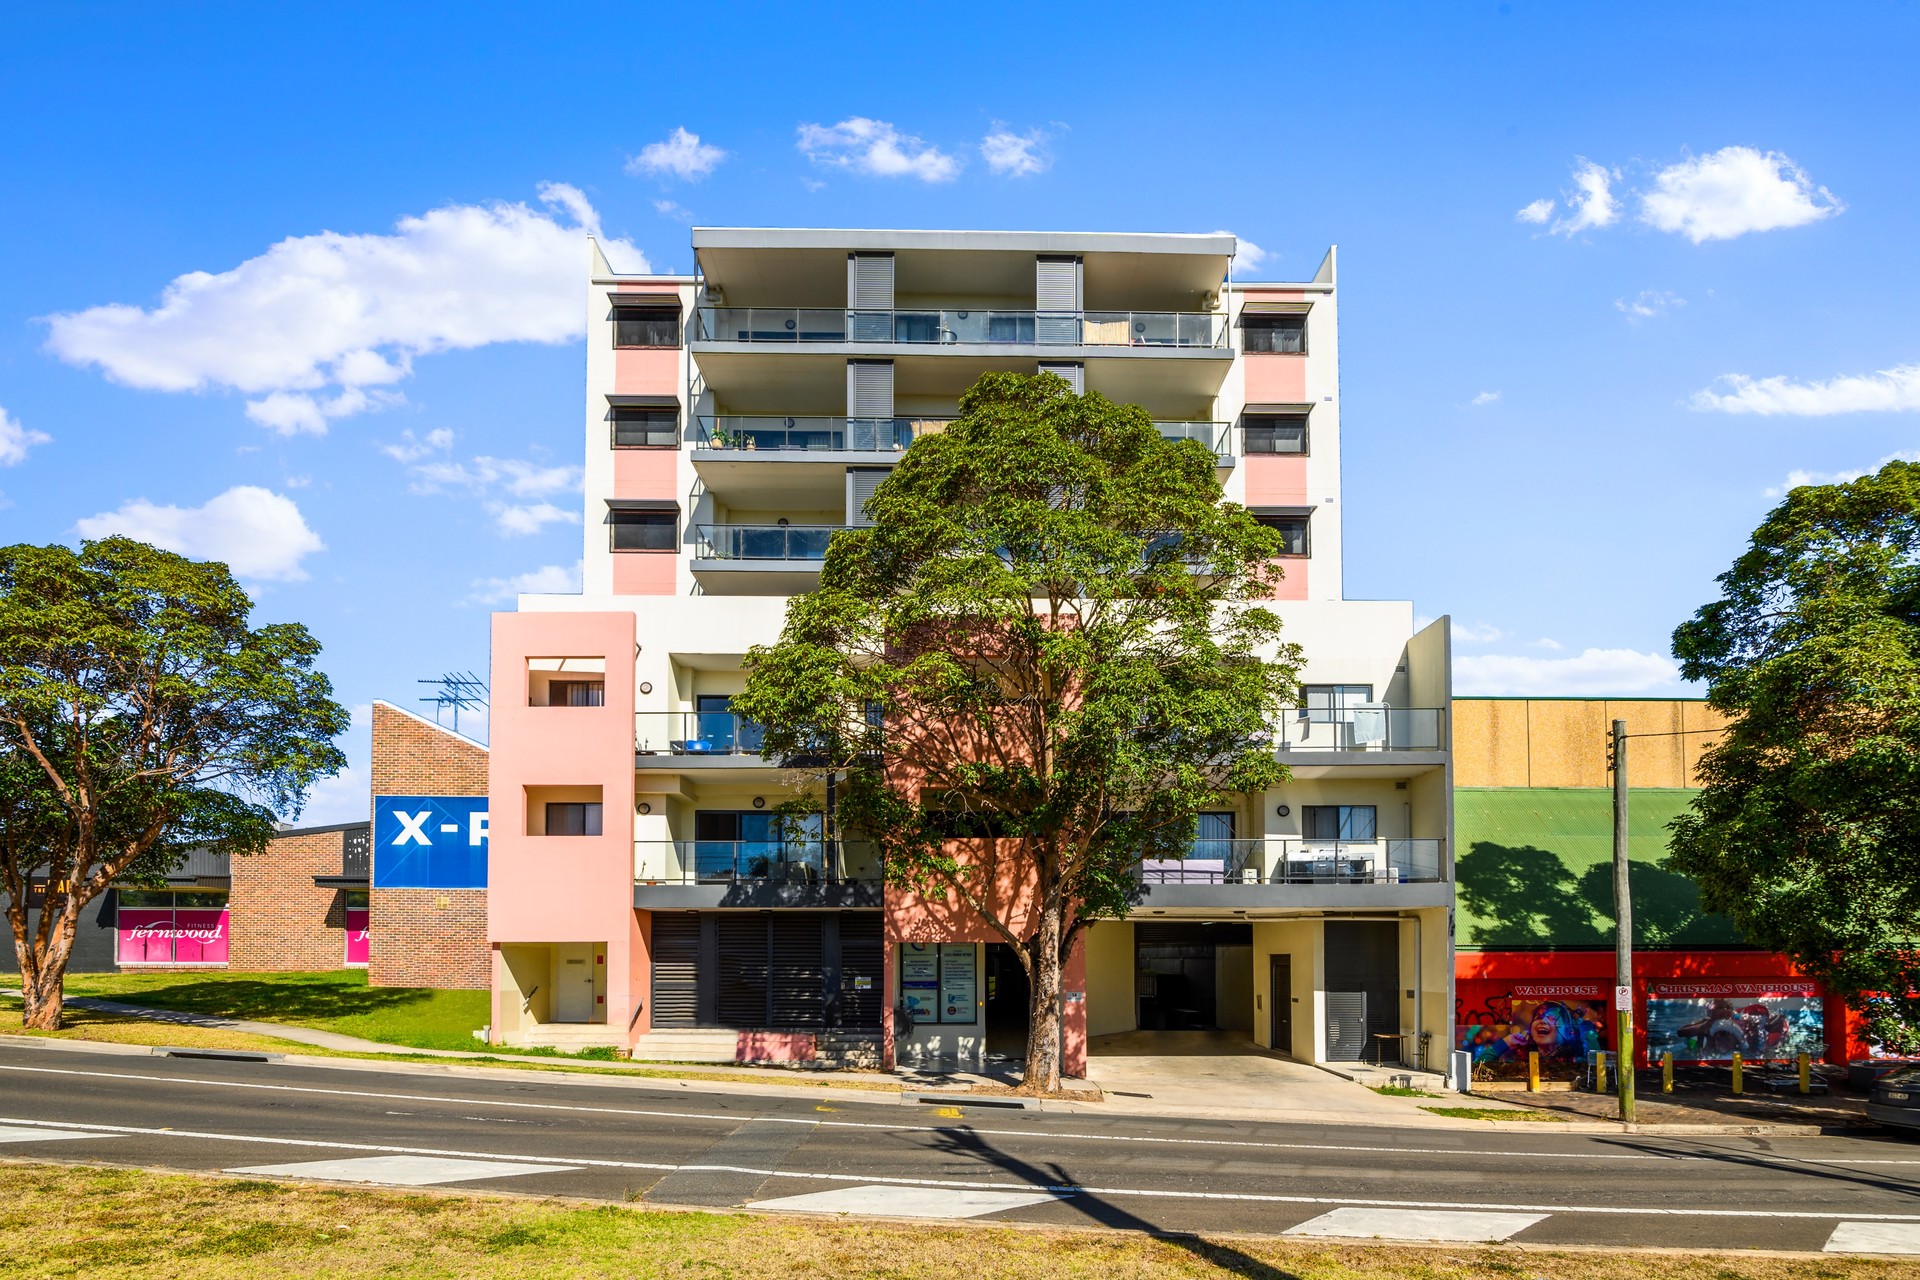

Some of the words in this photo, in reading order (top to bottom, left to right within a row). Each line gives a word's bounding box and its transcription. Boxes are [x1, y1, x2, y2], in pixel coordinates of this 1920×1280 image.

[126, 925, 222, 941] fernwood
[1515, 986, 1598, 995] WAREHOUSE
[1656, 983, 1733, 994] CHRISTMAS
[1735, 983, 1816, 994] WAREHOUSE
